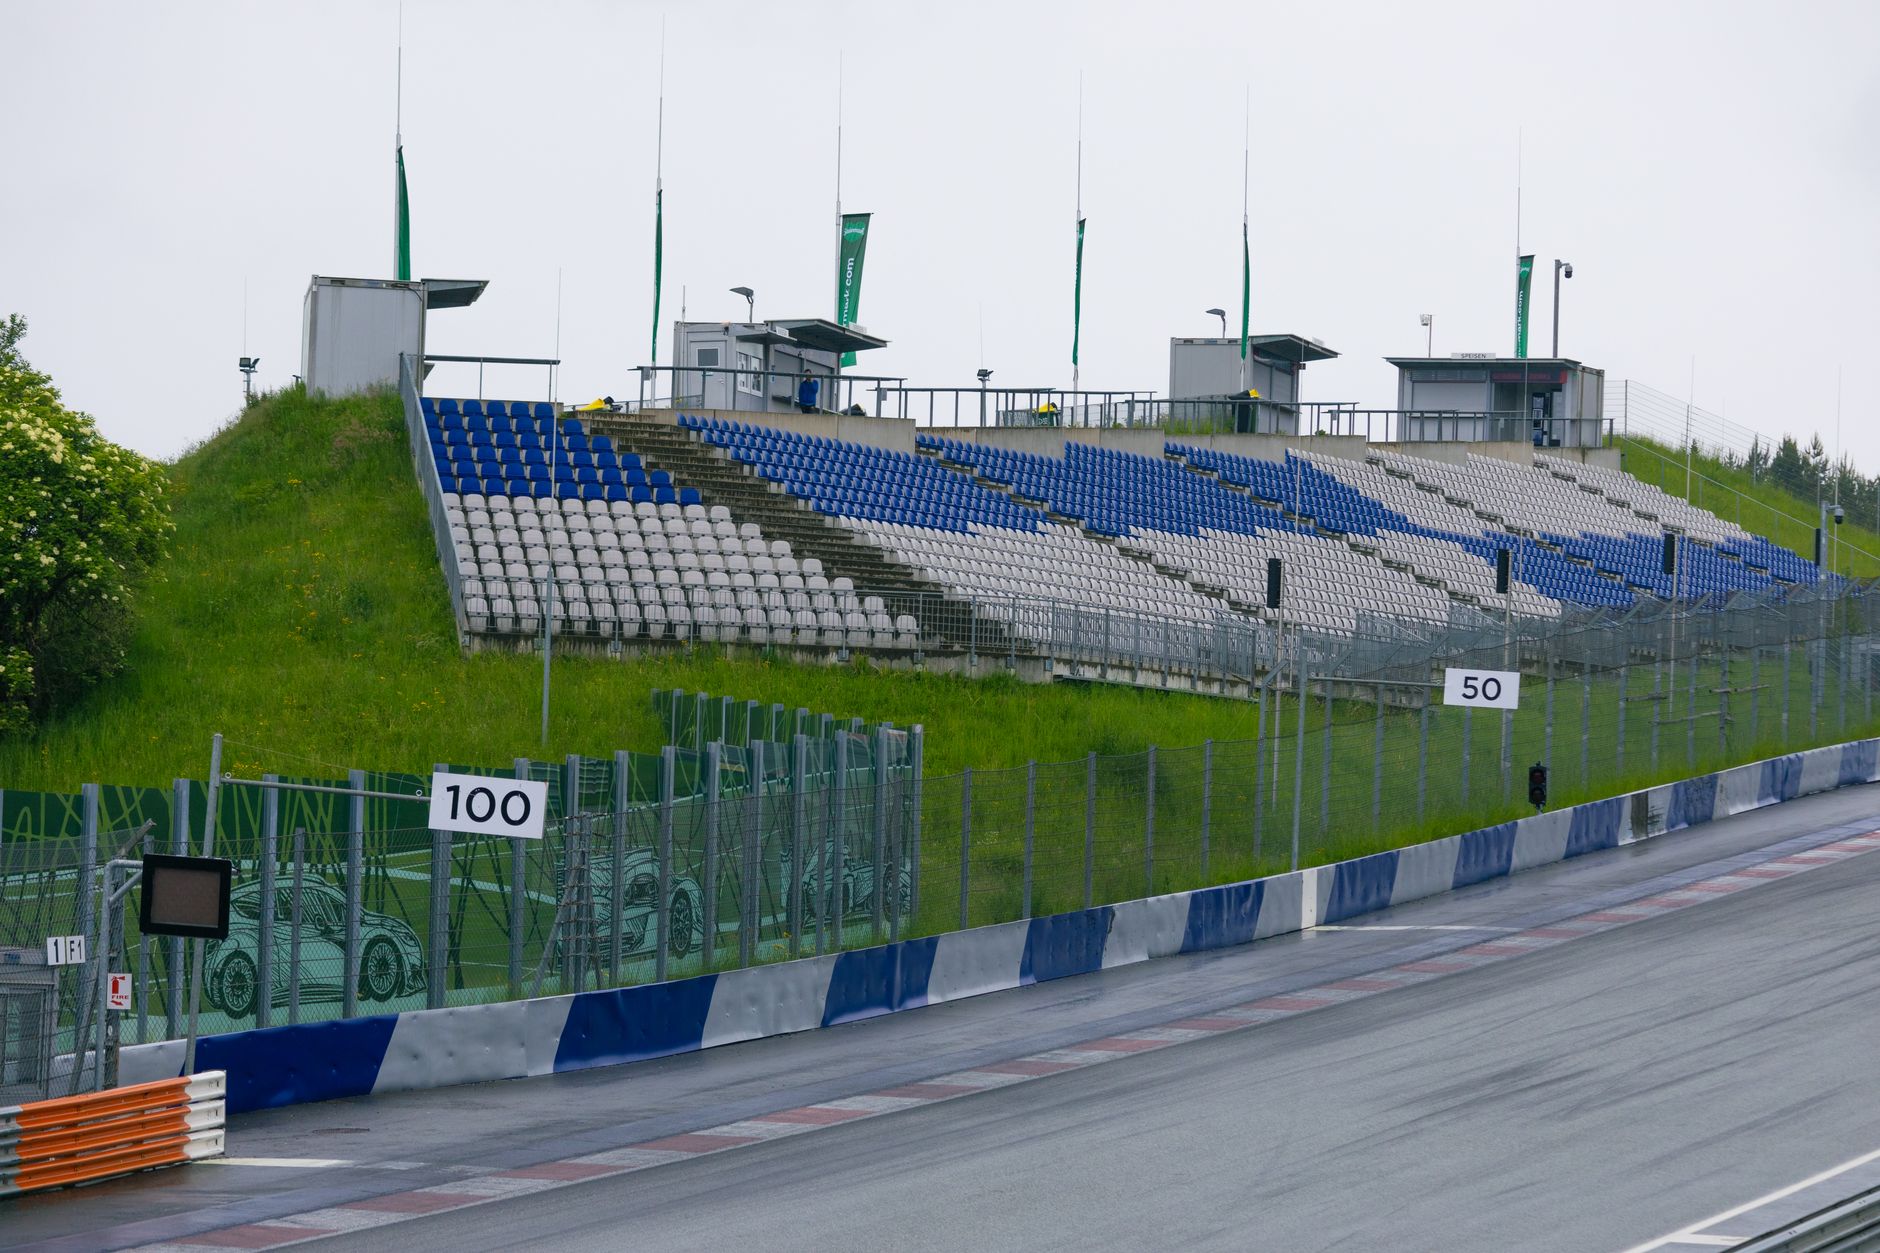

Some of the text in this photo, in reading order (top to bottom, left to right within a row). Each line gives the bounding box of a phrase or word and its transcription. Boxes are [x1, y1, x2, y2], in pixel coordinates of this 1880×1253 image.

[1461, 676, 1501, 701] 50
[446, 785, 531, 826] 100
[53, 938, 59, 963] 1
[69, 939, 82, 961] F1
